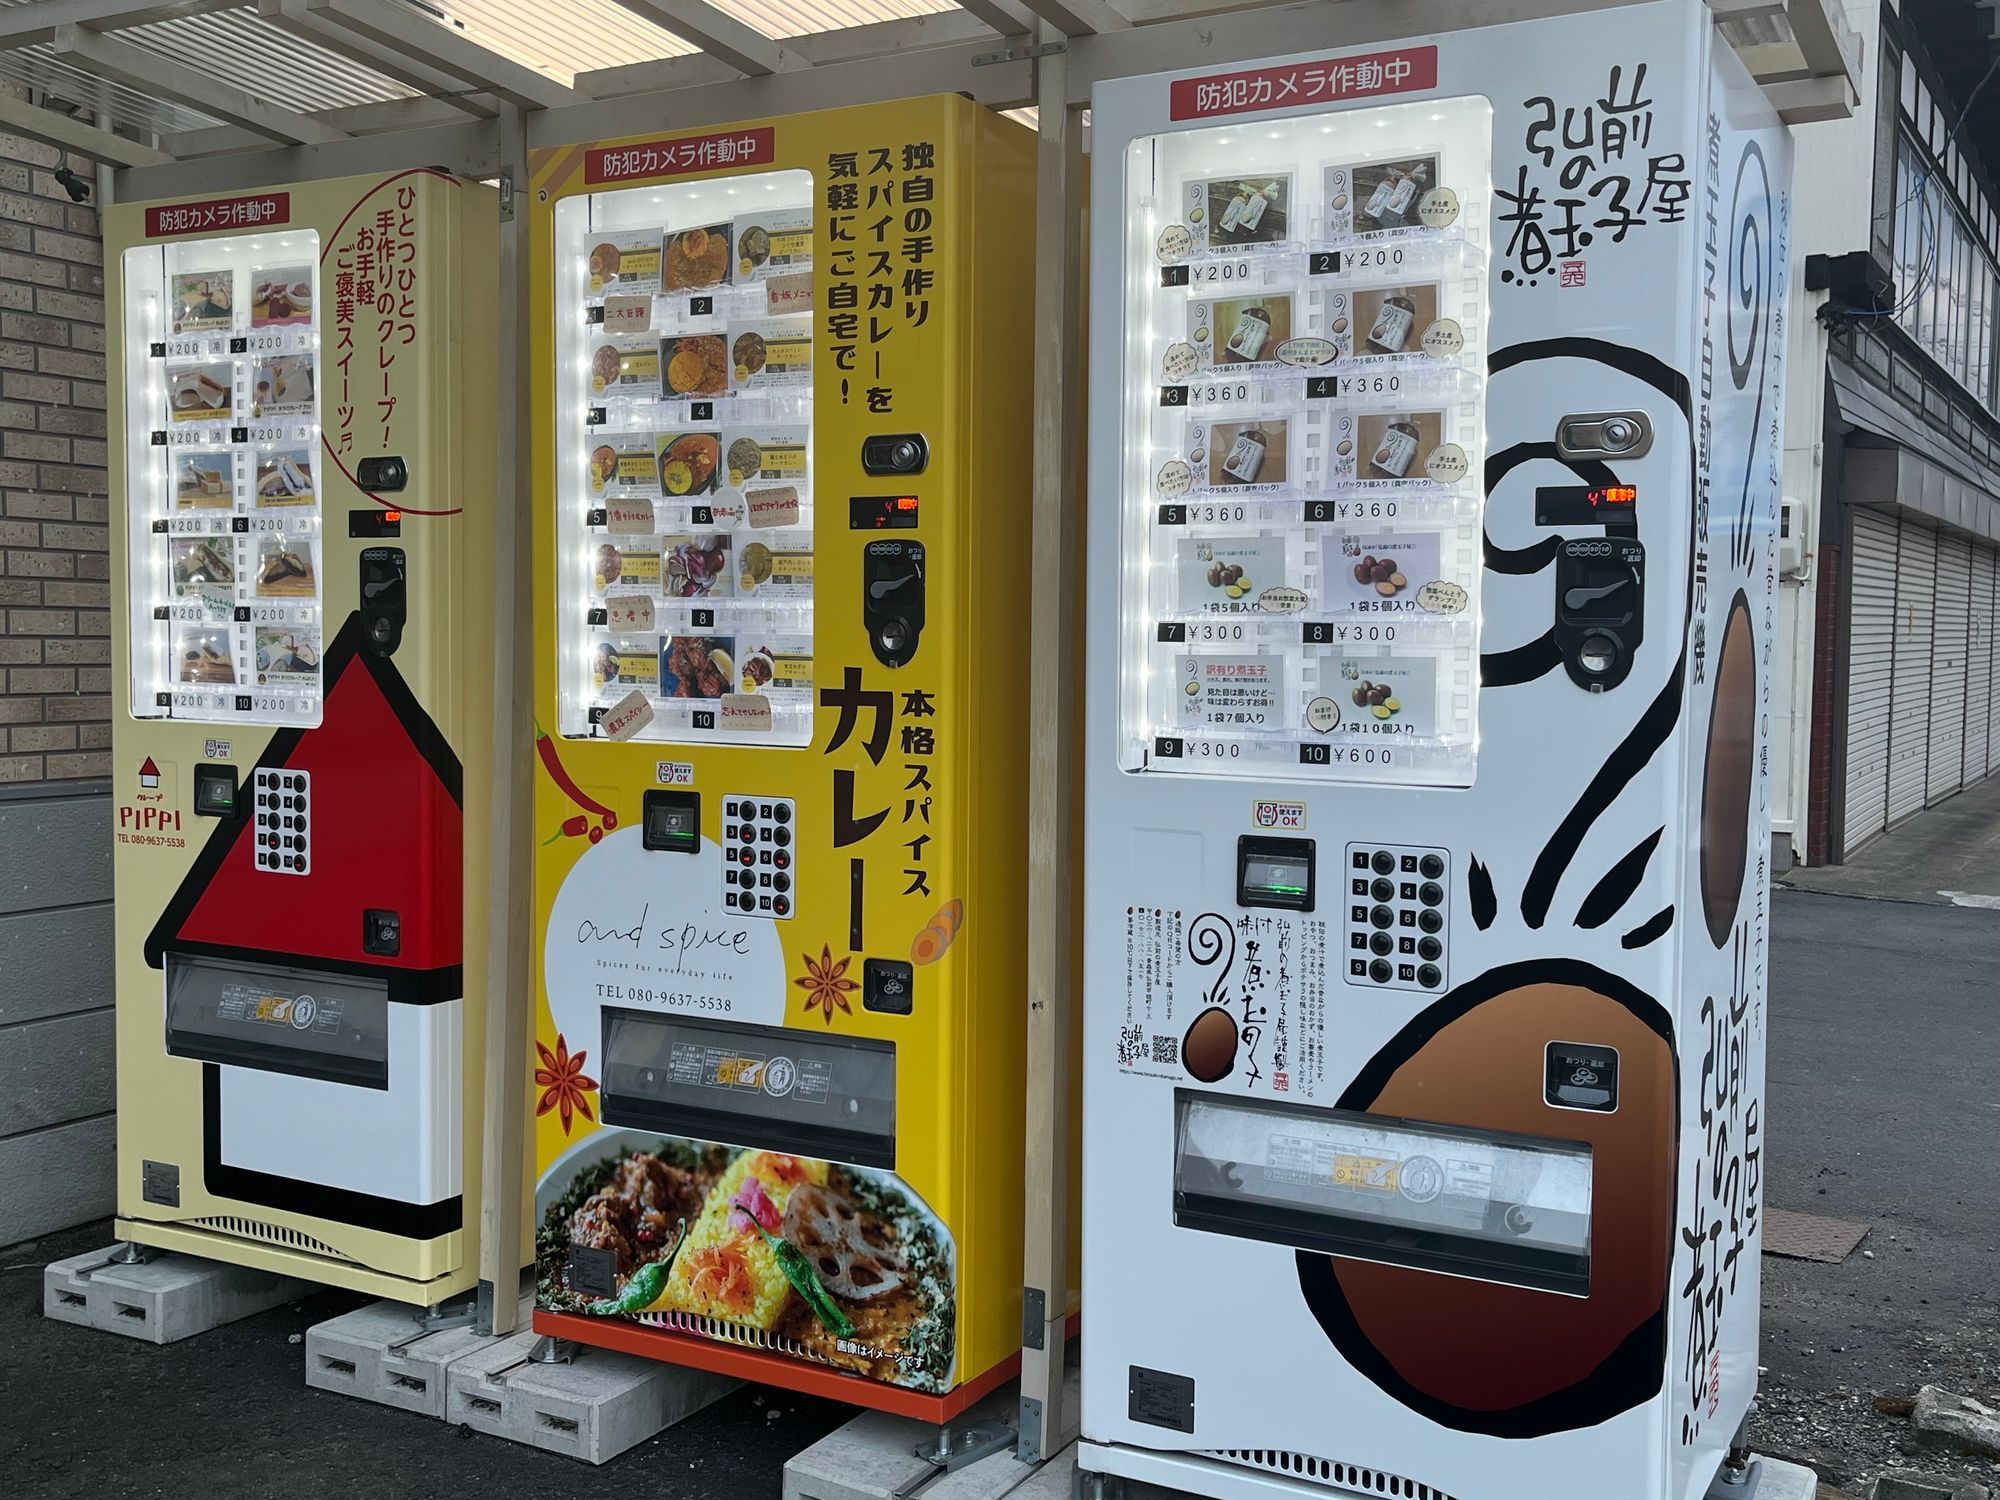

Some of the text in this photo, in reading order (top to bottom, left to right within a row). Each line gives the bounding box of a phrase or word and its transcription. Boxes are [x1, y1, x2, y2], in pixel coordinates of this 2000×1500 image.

[1196, 56, 1412, 113] 防犯カメラ作動中
[603, 135, 757, 178] 防犯カメラ作動中
[159, 199, 277, 232] 防犯カメラ作動中
[901, 141, 935, 328] 独自の手作り
[355, 227, 376, 306] お手軽
[397, 185, 417, 345] ひとつひとつ
[1320, 256, 1329, 270] 2
[826, 151, 860, 405] 気軽にご自宅で！
[865, 147, 895, 414] スパイスカレーを
[376, 209, 397, 449] 手作りのクレープ！
[1169, 389, 1178, 403] 3
[1316, 381, 1326, 394] 4
[1167, 508, 1176, 521] 5
[1314, 504, 1324, 518] 6
[1621, 547, 1643, 555] おつり
[1168, 626, 1176, 638] 7
[1313, 626, 1323, 640] 8
[1206, 664, 1267, 676] 訳有り煮玉子
[697, 714, 710, 726] 10
[1164, 741, 1174, 755] 9
[1305, 747, 1323, 761] 10
[900, 688, 936, 898] 本格スパイス
[119, 806, 181, 831] PIPPI
[820, 665, 894, 953] カレー
[1282, 816, 1298, 826] OK
[117, 833, 185, 849] TEL 080-9637-5538
[577, 902, 750, 973] and spice
[596, 959, 734, 982] Spices for everyday life
[596, 983, 732, 1012] TEL 080-9637-5538
[836, 1338, 925, 1370] 画像はイメージです
